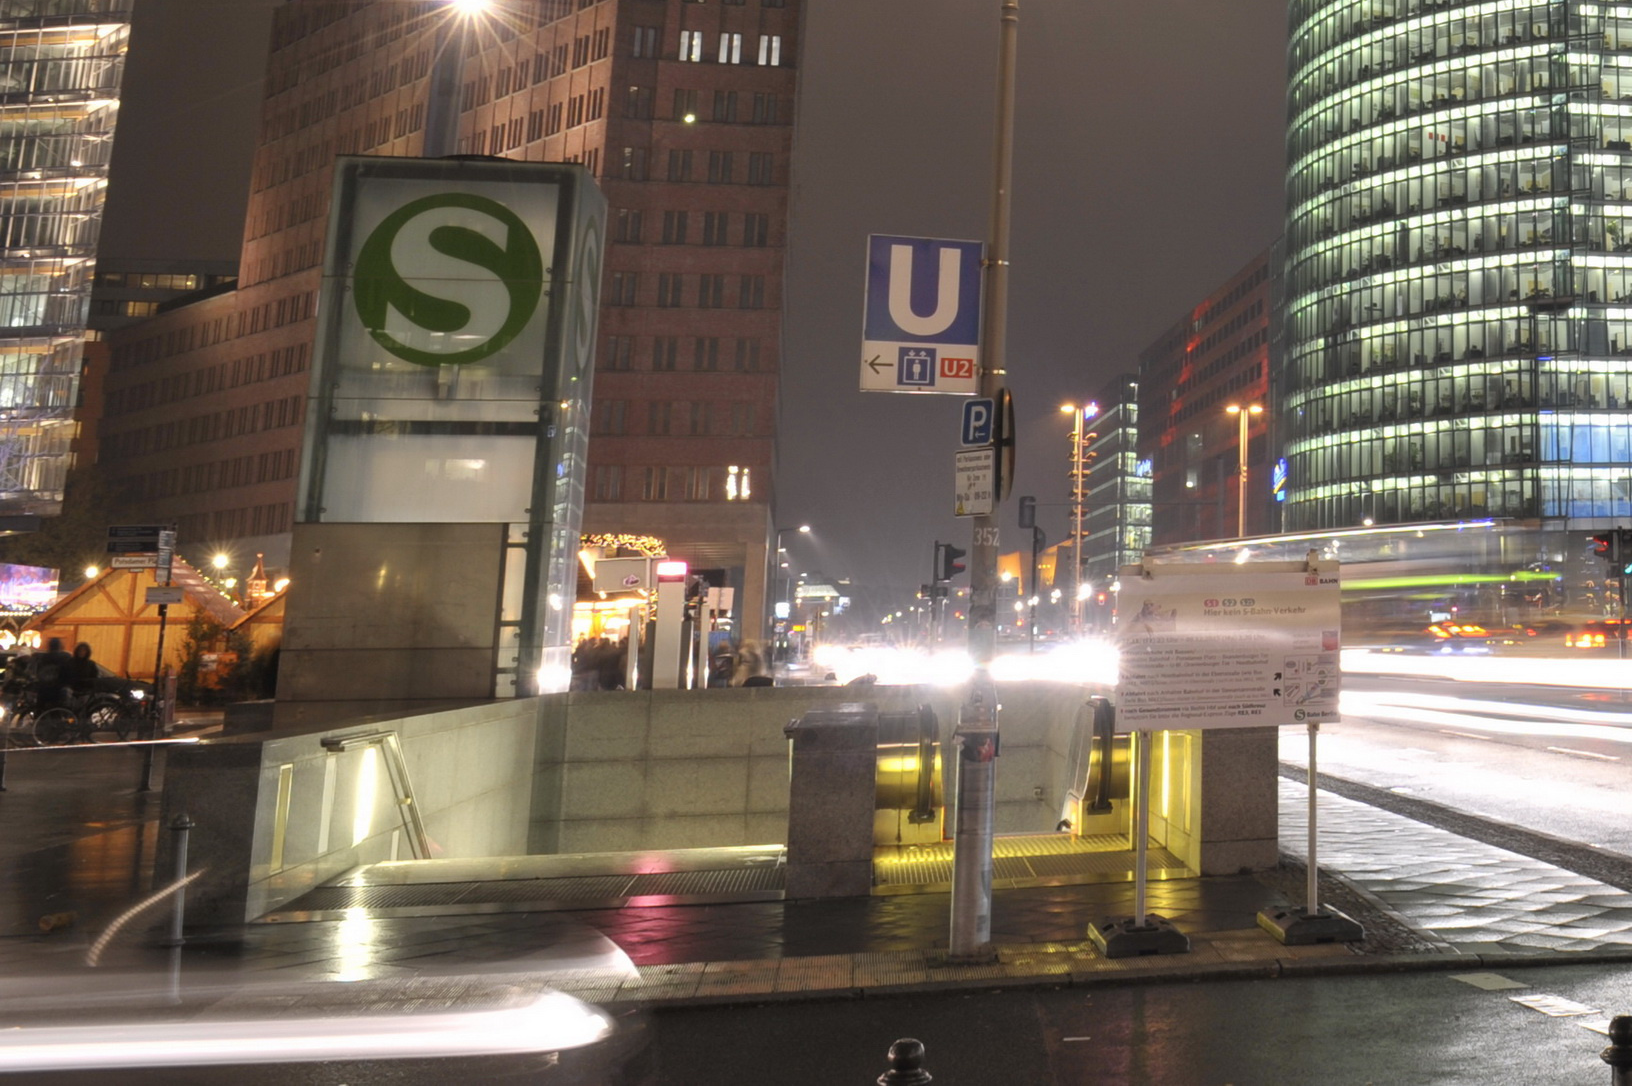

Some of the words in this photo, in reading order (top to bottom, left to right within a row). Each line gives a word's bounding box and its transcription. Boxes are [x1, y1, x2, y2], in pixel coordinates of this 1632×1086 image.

[384, 206, 511, 354] S
[888, 244, 962, 336] U
[943, 360, 970, 377] U2
[968, 405, 987, 441] P
[1203, 608, 1222, 616] Hier
